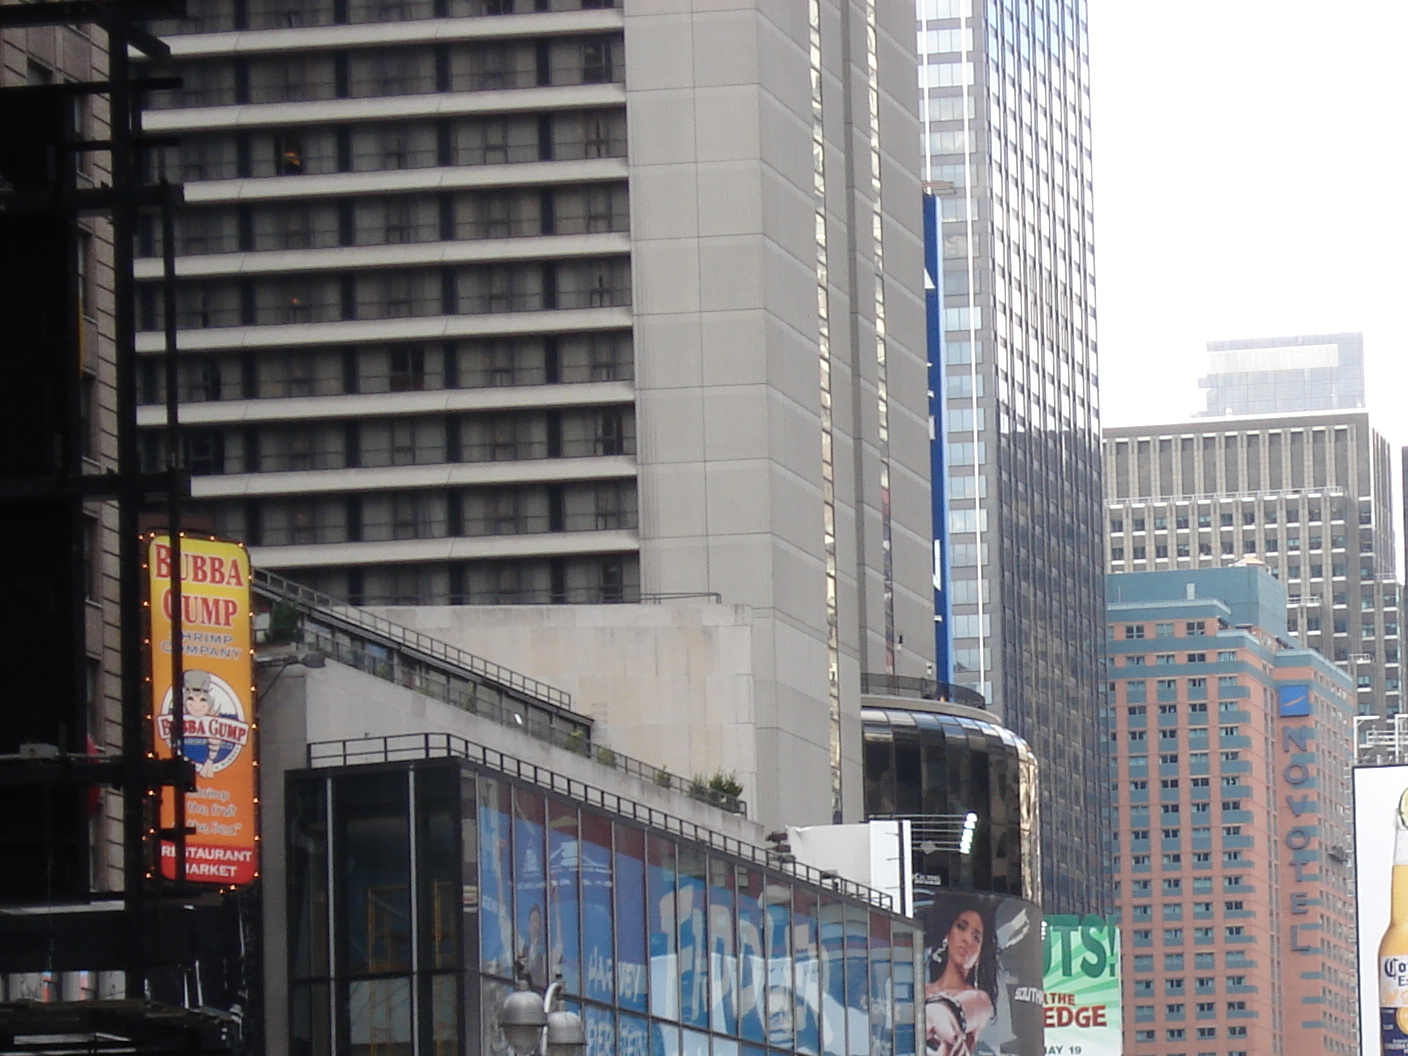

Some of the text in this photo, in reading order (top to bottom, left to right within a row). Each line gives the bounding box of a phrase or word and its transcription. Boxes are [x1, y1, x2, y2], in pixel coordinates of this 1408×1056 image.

[181, 632, 233, 645] HRIMP
[160, 640, 241, 660] CMPANY
[161, 717, 247, 742] BBBA GUMP
[1283, 725, 1311, 953] NOVOTEL
[1050, 992, 1077, 1006] THE
[1069, 1045, 1082, 1056] 19
